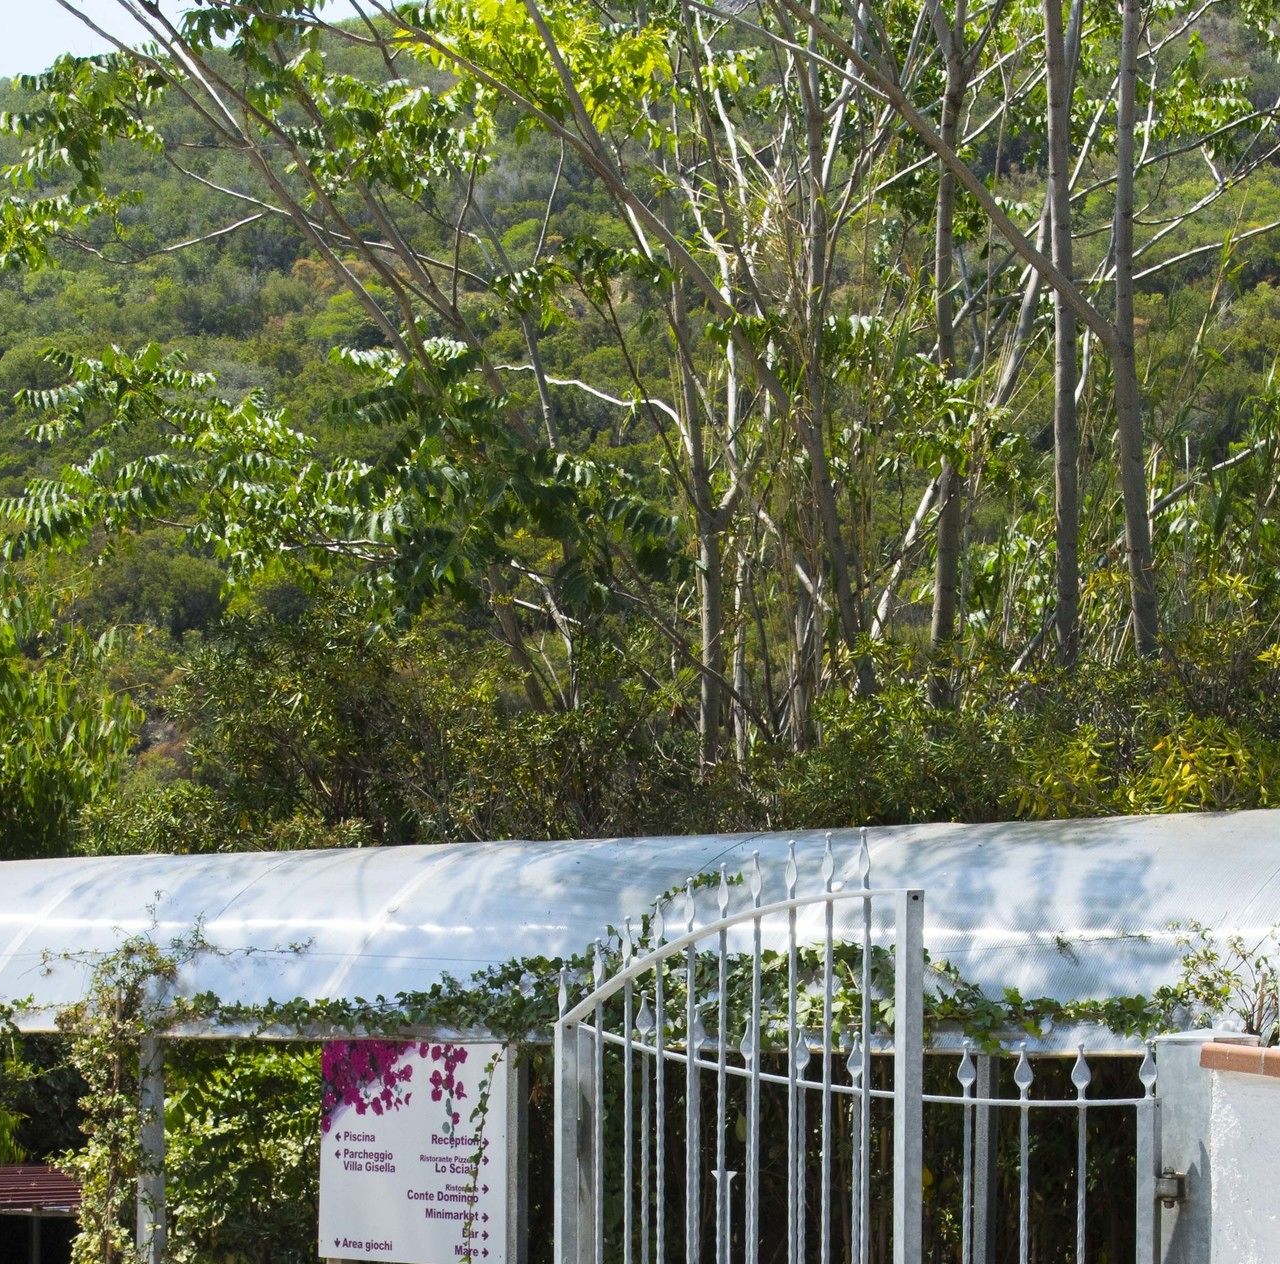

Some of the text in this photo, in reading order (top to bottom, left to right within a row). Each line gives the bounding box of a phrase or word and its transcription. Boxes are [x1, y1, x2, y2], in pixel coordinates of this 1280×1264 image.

[343, 1131, 376, 1142] Piscina
[431, 1134, 479, 1147] Reception
[343, 1148, 393, 1162] Parcheggio
[420, 1154, 452, 1163] Ristorante
[343, 1160, 396, 1173] Villa Gisella
[435, 1162, 447, 1173] Lo
[445, 1184, 479, 1193] Ristoe
[406, 1189, 479, 1204] Conte Domingo
[425, 1208, 479, 1221] Minimarket
[342, 1238, 393, 1252] Area giochi
[454, 1245, 479, 1257] Mare
